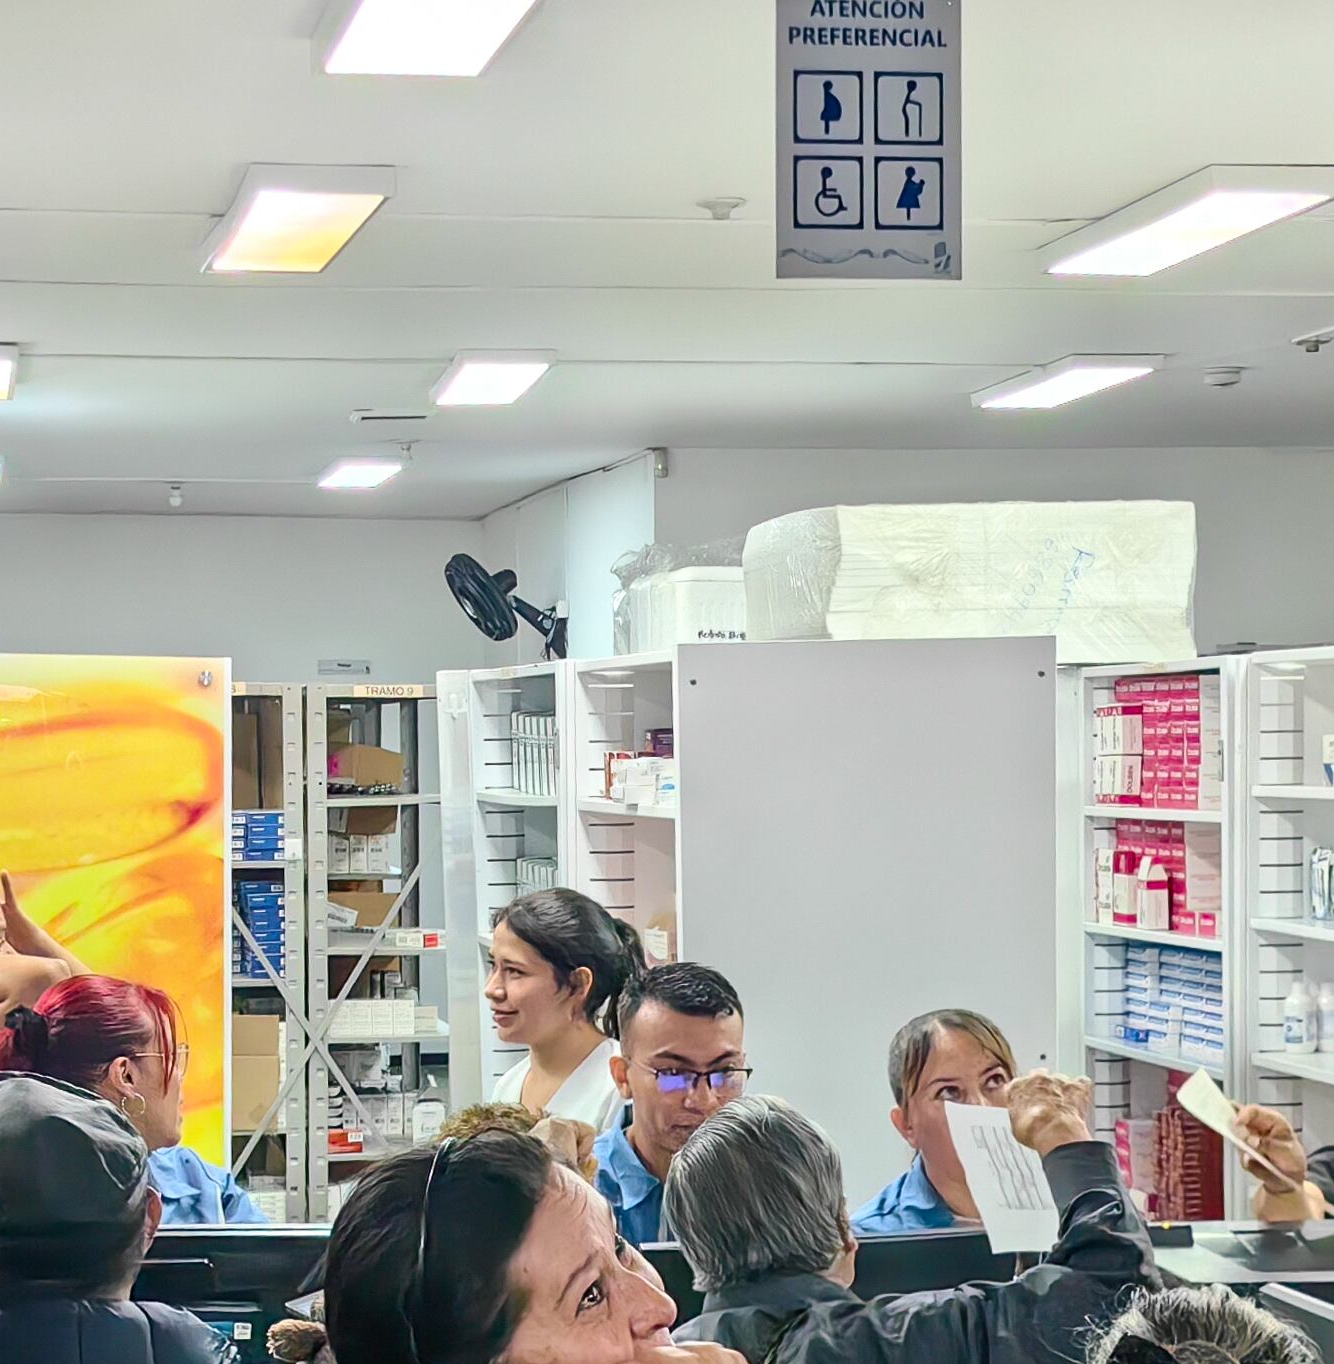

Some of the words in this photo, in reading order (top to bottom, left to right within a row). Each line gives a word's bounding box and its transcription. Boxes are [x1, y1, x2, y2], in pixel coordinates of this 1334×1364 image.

[788, 26, 947, 48] PREFERENCIAL
[365, 686, 404, 696] TRAMO
[407, 688, 414, 696] 9
